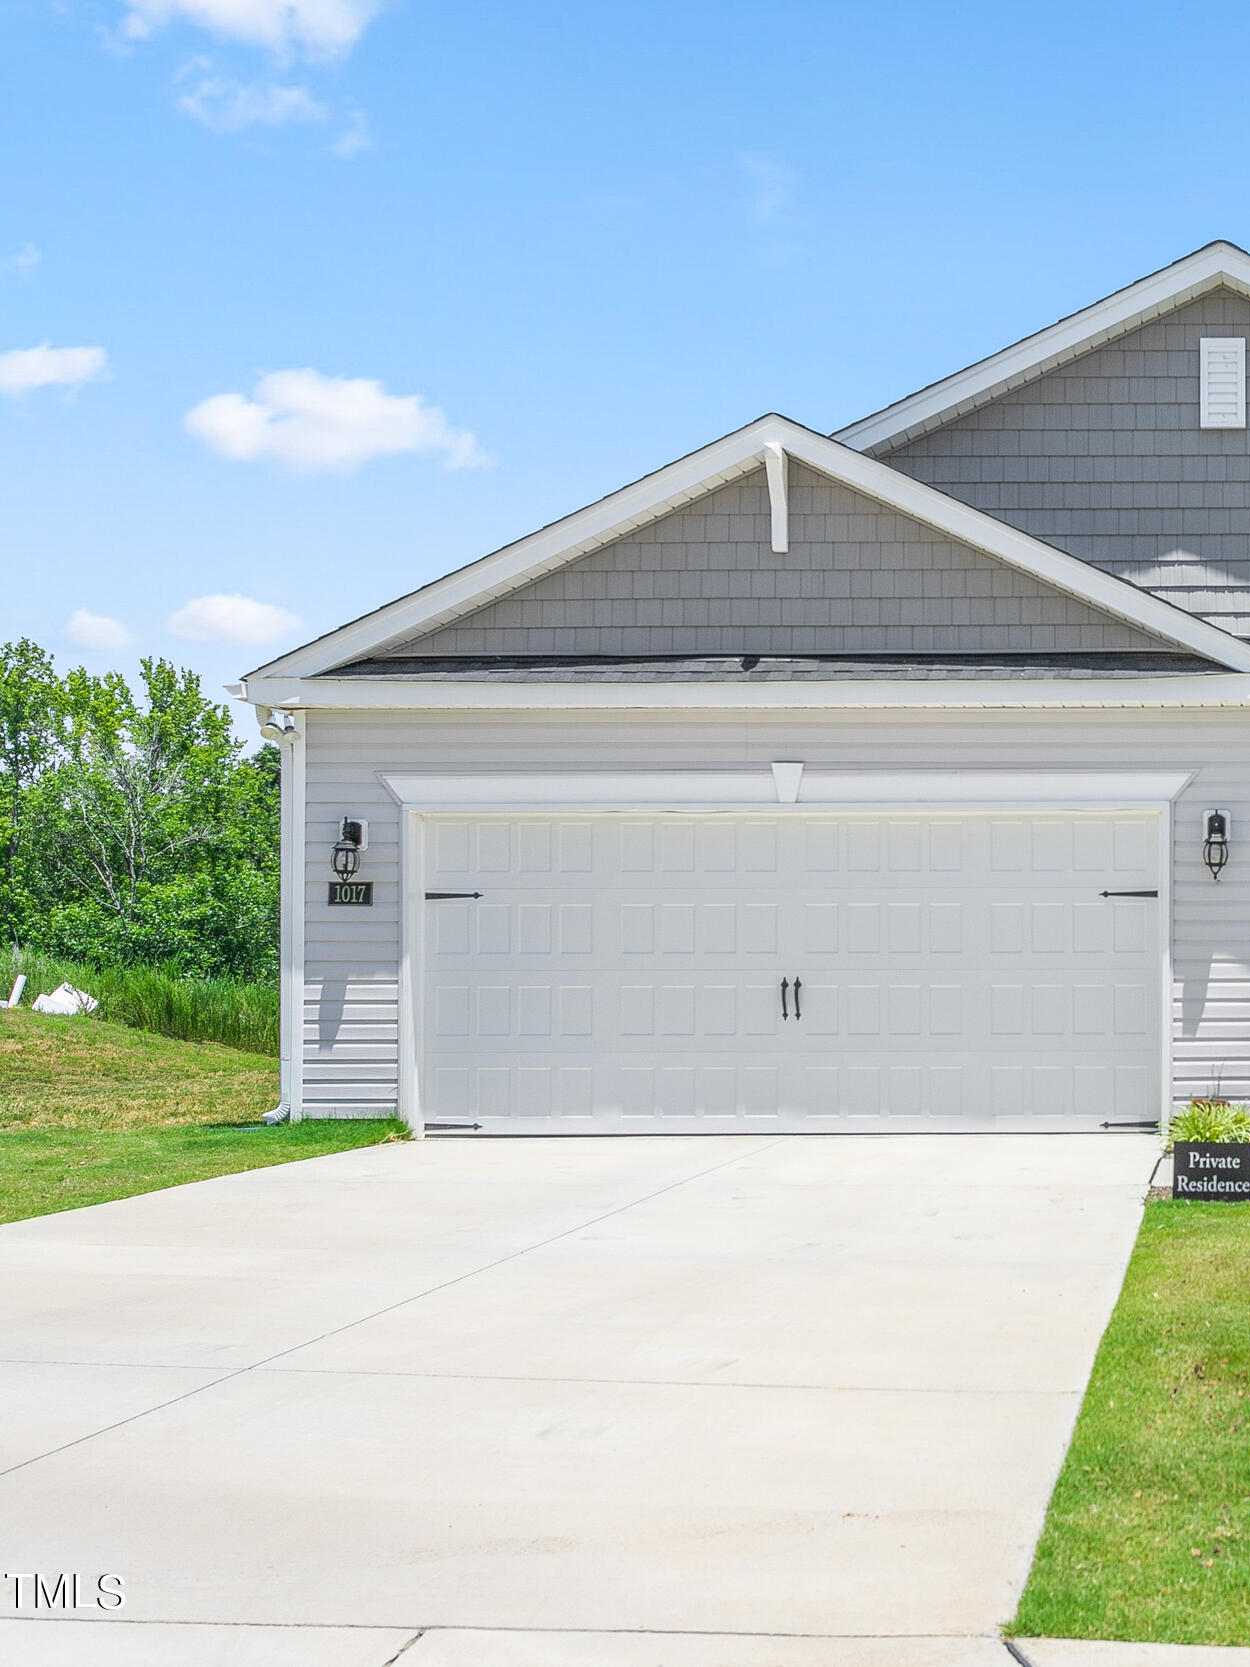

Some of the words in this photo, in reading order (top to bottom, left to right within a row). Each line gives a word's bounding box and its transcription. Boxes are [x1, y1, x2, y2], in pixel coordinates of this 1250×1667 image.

[334, 885, 366, 902] 1017
[1188, 1151, 1241, 1169] Private
[1177, 1174, 1250, 1193] Residence
